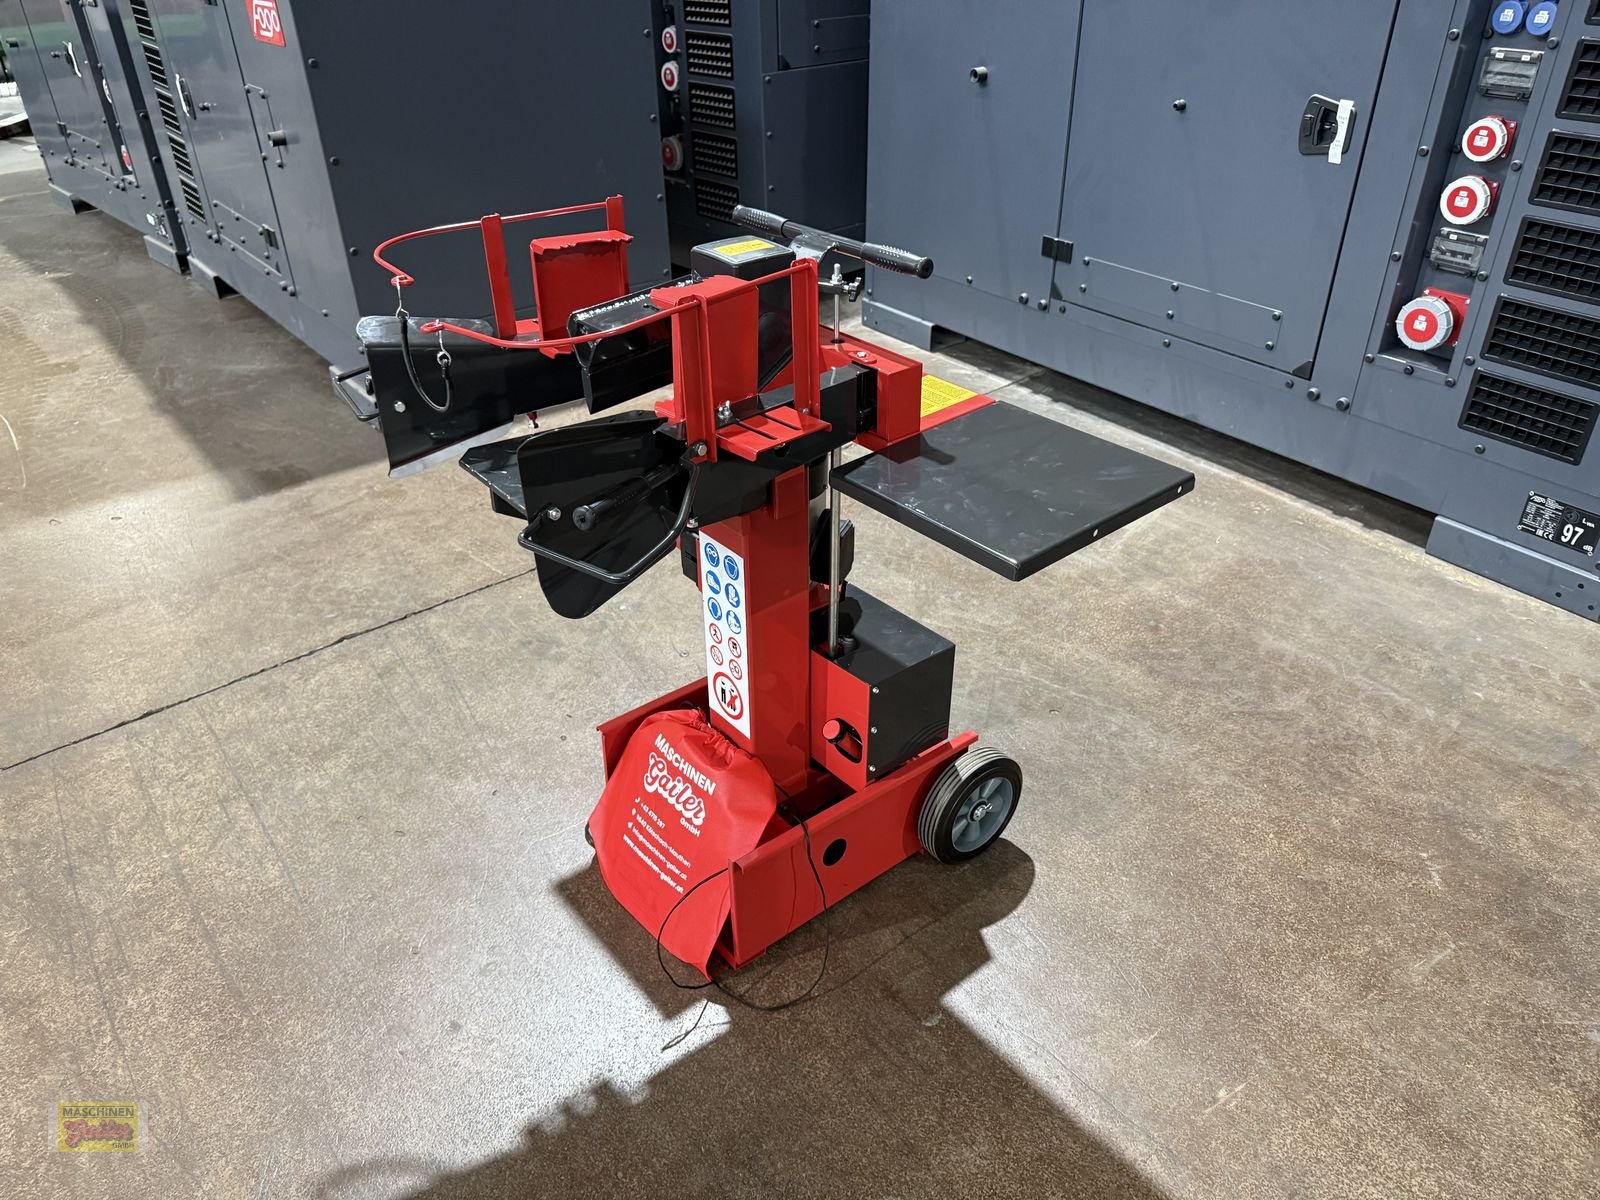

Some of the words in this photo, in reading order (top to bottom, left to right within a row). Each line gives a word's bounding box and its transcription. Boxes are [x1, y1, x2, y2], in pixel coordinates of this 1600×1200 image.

[1561, 524, 1584, 545] 97
[644, 752, 705, 825] Gailer
[655, 733, 716, 795] MASCHINEN
[680, 817, 701, 837] GmbH
[623, 833, 684, 894] www.maschinen-gailer.at
